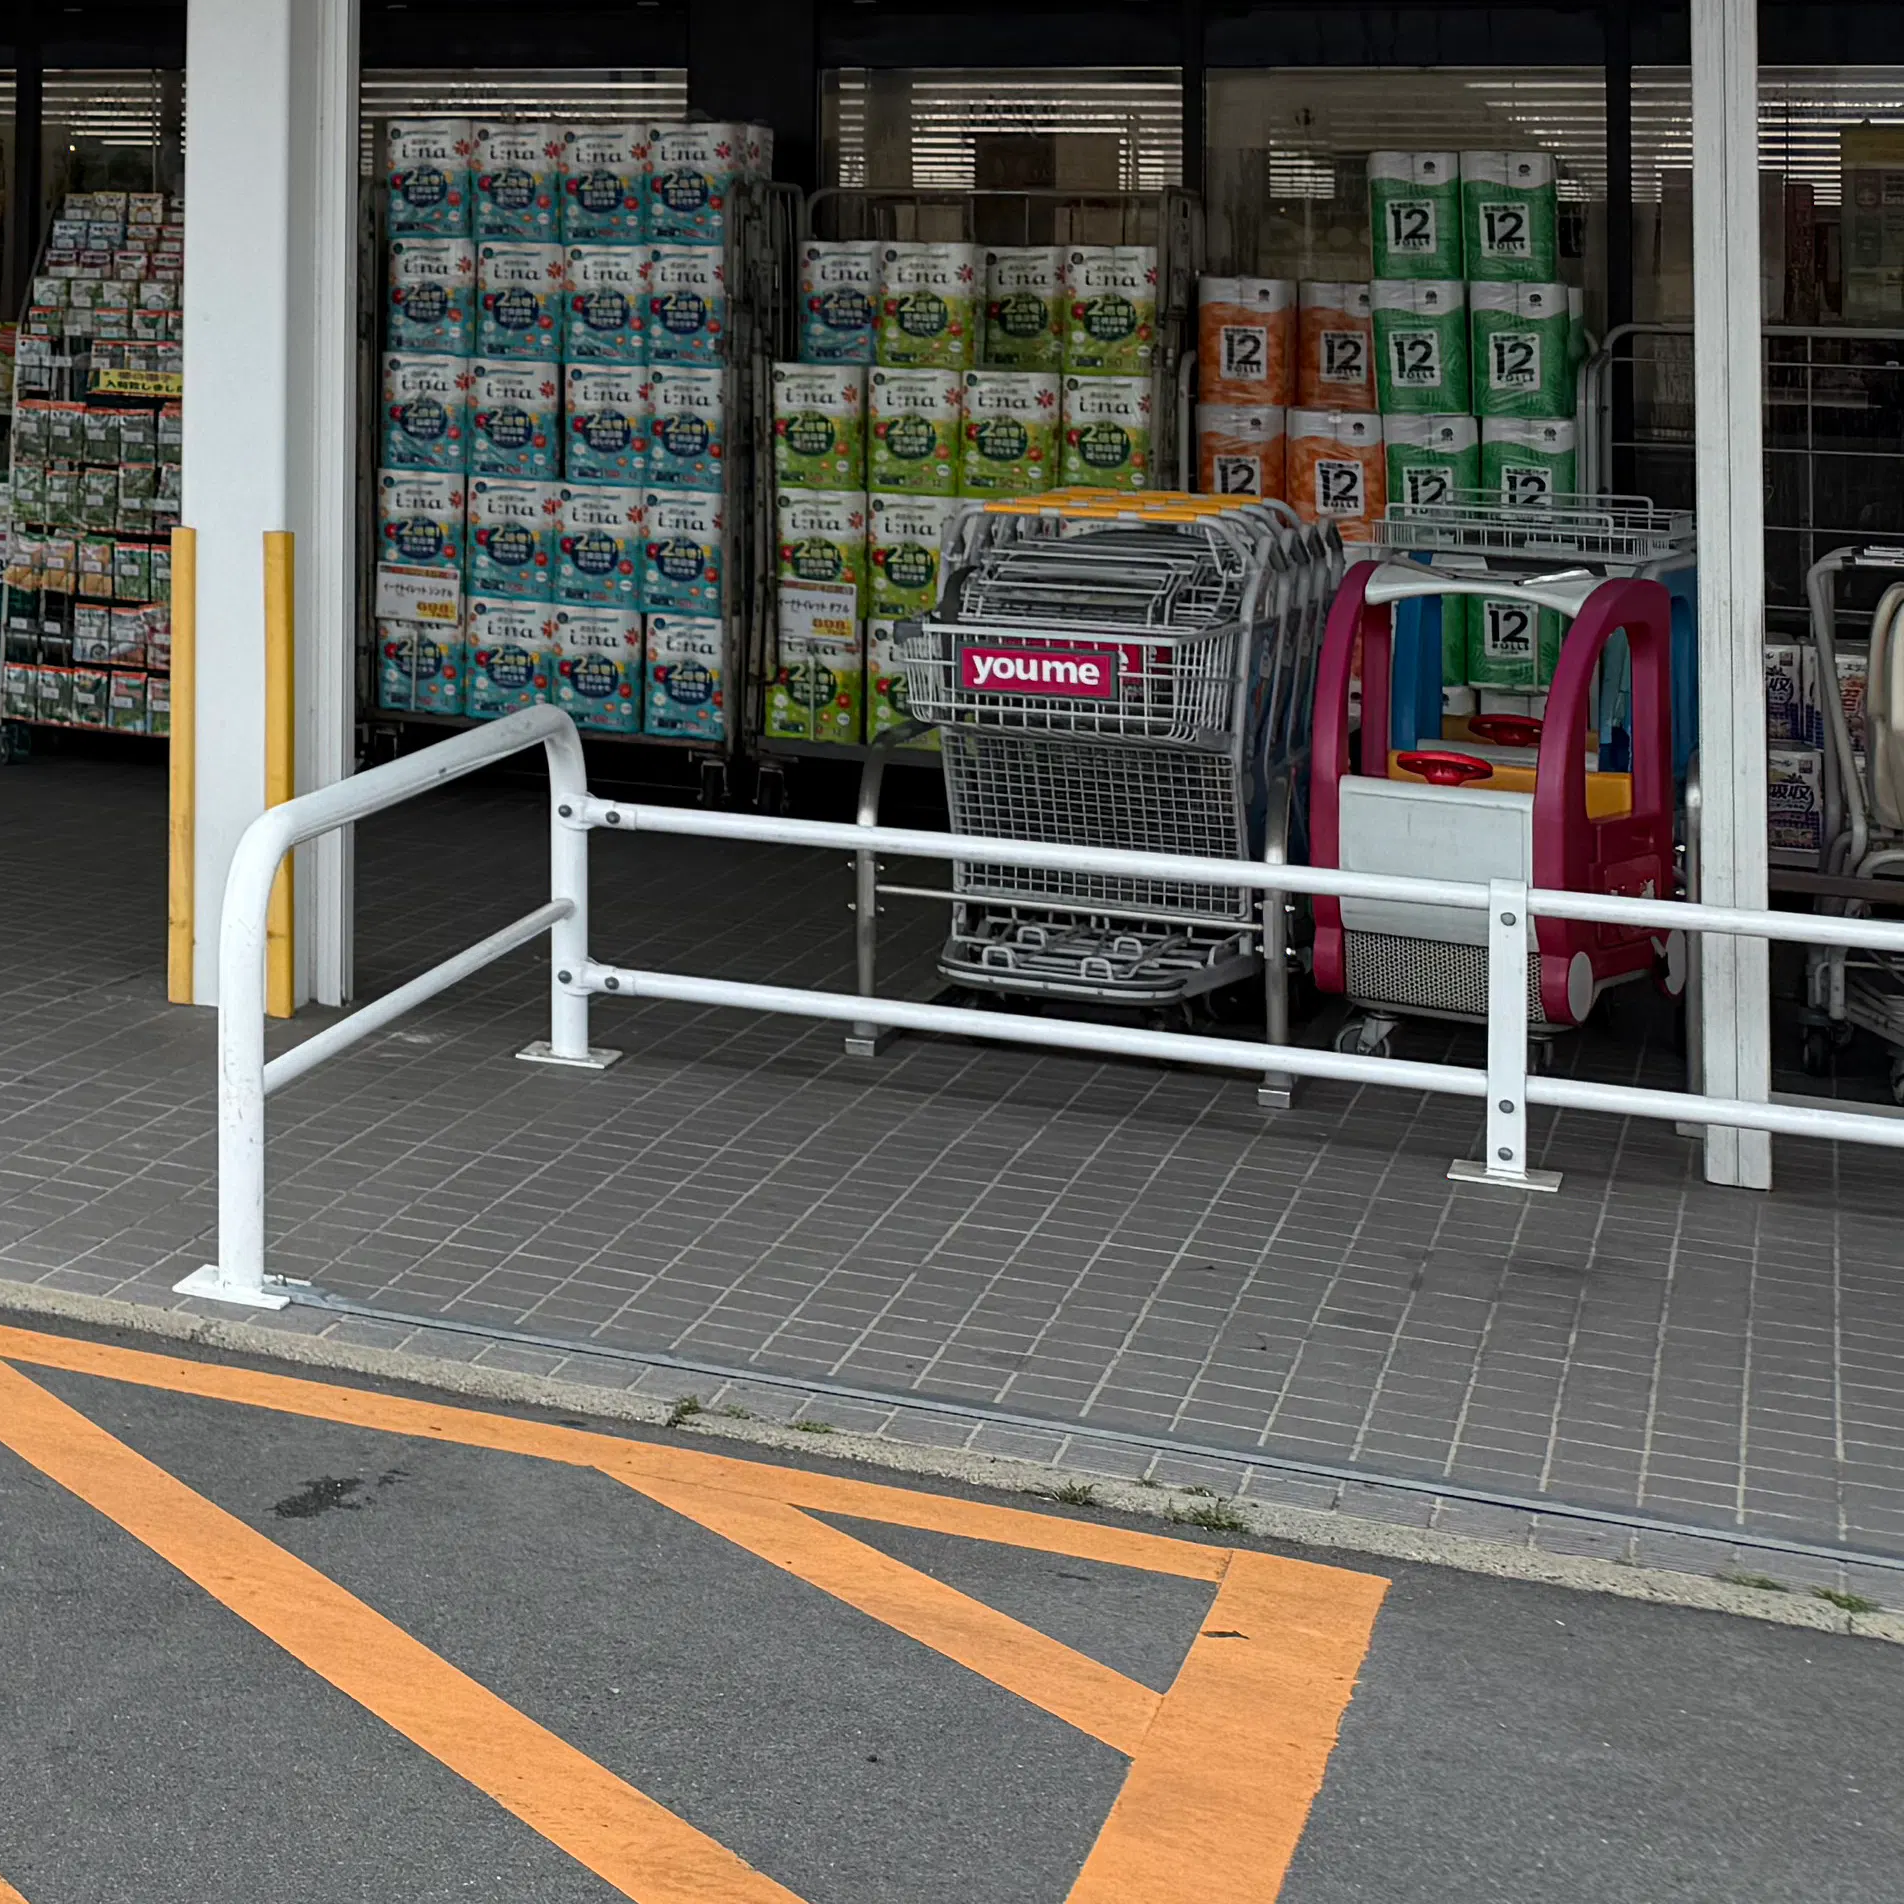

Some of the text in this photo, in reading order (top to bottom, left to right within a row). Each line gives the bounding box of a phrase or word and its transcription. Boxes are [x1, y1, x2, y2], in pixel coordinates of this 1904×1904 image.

[1391, 209, 1430, 240] 12
[1484, 212, 1525, 243] 12
[1225, 334, 1261, 365] 12
[1325, 339, 1362, 370] 12
[1394, 340, 1434, 372] 12
[1494, 342, 1534, 374] 12
[1219, 464, 1256, 495] 12
[1321, 470, 1359, 502] 12
[1408, 475, 1447, 504] 12
[1507, 476, 1546, 504] 12
[1490, 610, 1529, 643] 12
[972, 654, 1100, 686] youme
